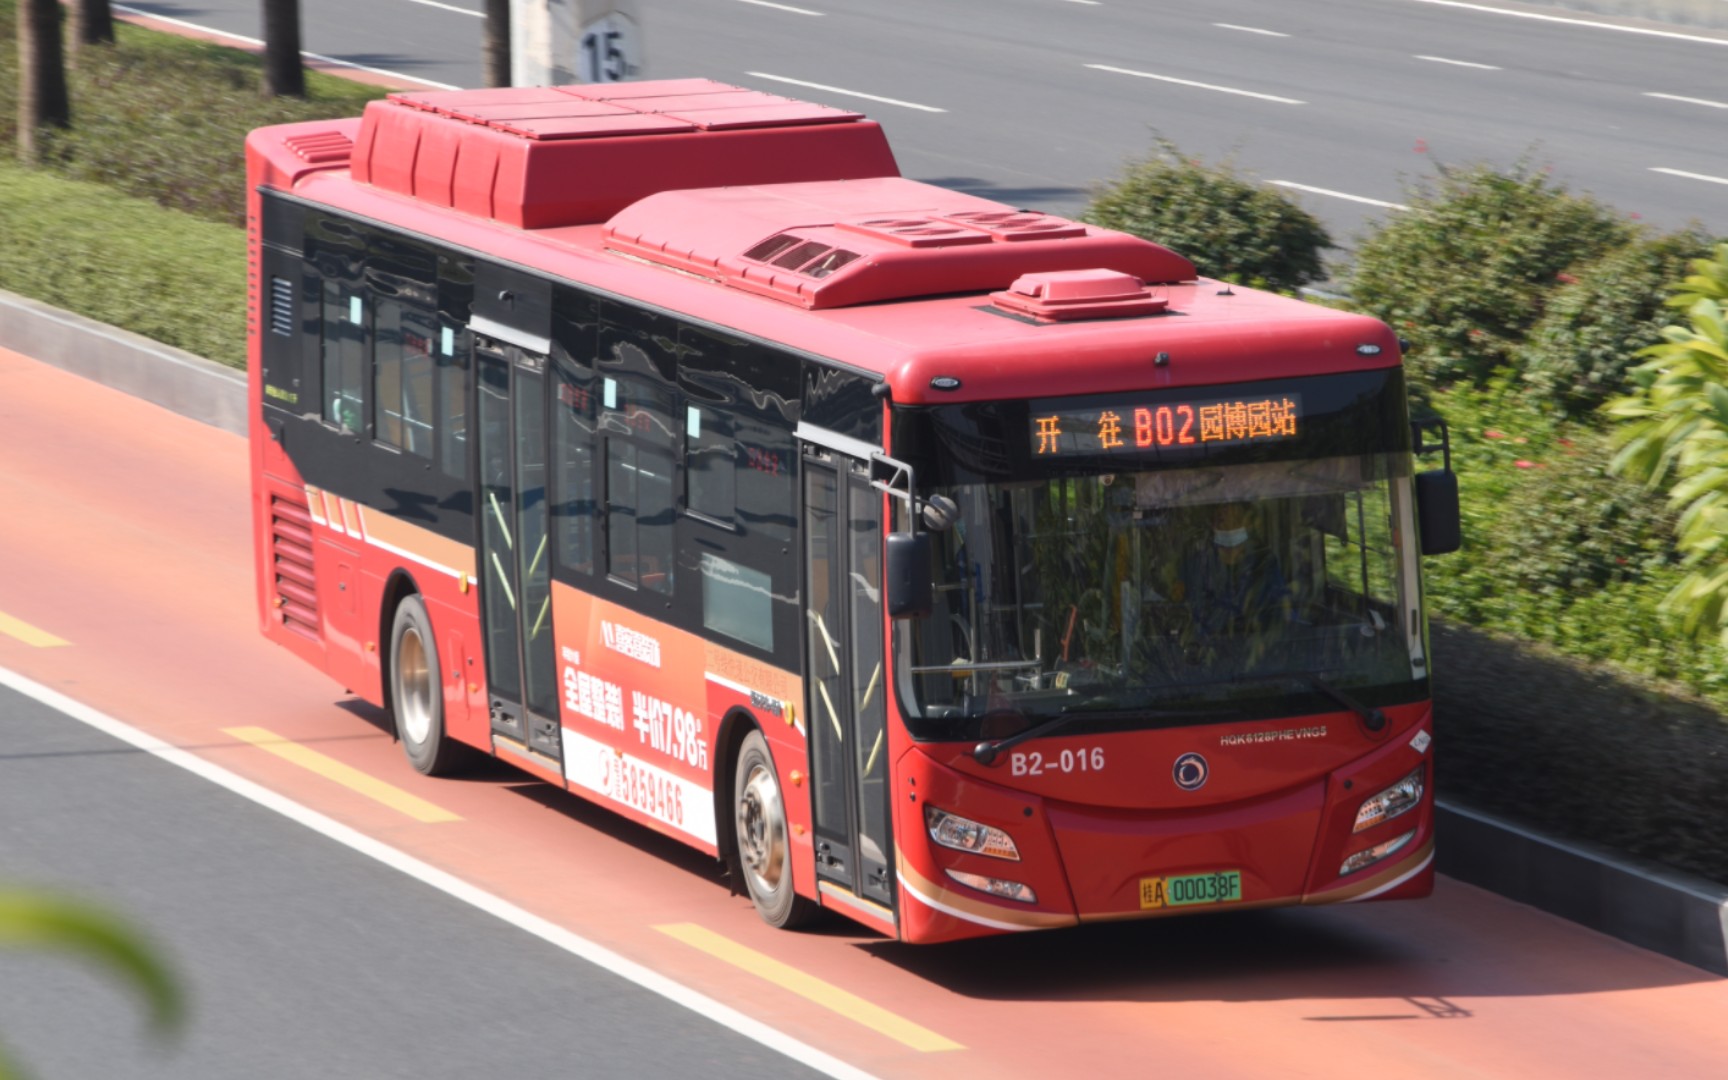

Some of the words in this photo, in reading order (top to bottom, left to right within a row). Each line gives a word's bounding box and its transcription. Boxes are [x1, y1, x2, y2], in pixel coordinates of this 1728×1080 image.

[1134, 404, 1195, 447] B02
[1199, 398, 1296, 441] 园博园站
[1011, 747, 1105, 776] B2-016
[621, 761, 684, 826] 5859466
